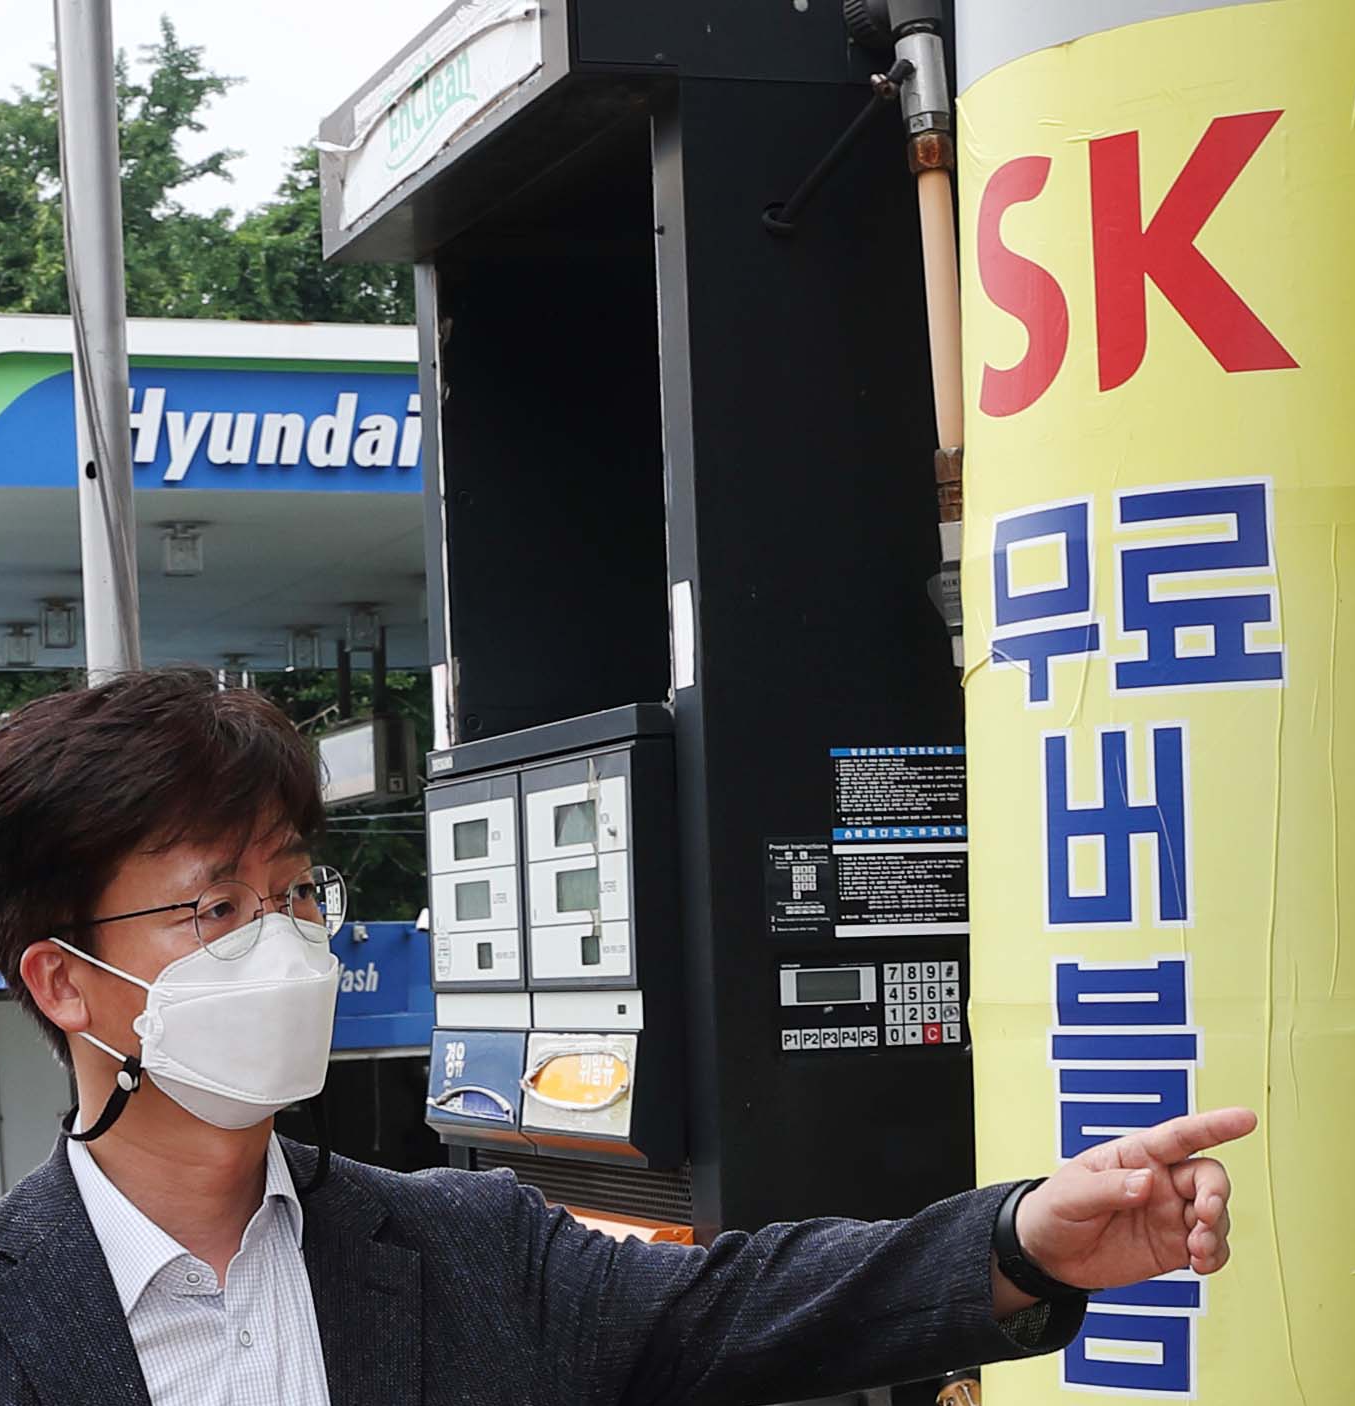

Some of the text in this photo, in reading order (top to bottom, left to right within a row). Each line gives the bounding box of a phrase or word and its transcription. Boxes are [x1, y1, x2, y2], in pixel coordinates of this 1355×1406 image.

[977, 109, 1301, 418] SK
[128, 387, 423, 480] Hyundai
[988, 476, 1287, 708] 무료
[888, 966, 897, 980] 7
[907, 966, 917, 980] 8
[927, 965, 936, 979] 9
[889, 986, 936, 1001] 4 5 6
[908, 1007, 918, 1021] 2
[927, 1006, 937, 1020] 3
[784, 1030, 876, 1045] P1 P2 P3 P4 P5
[890, 1026, 956, 1042] 0 C L
